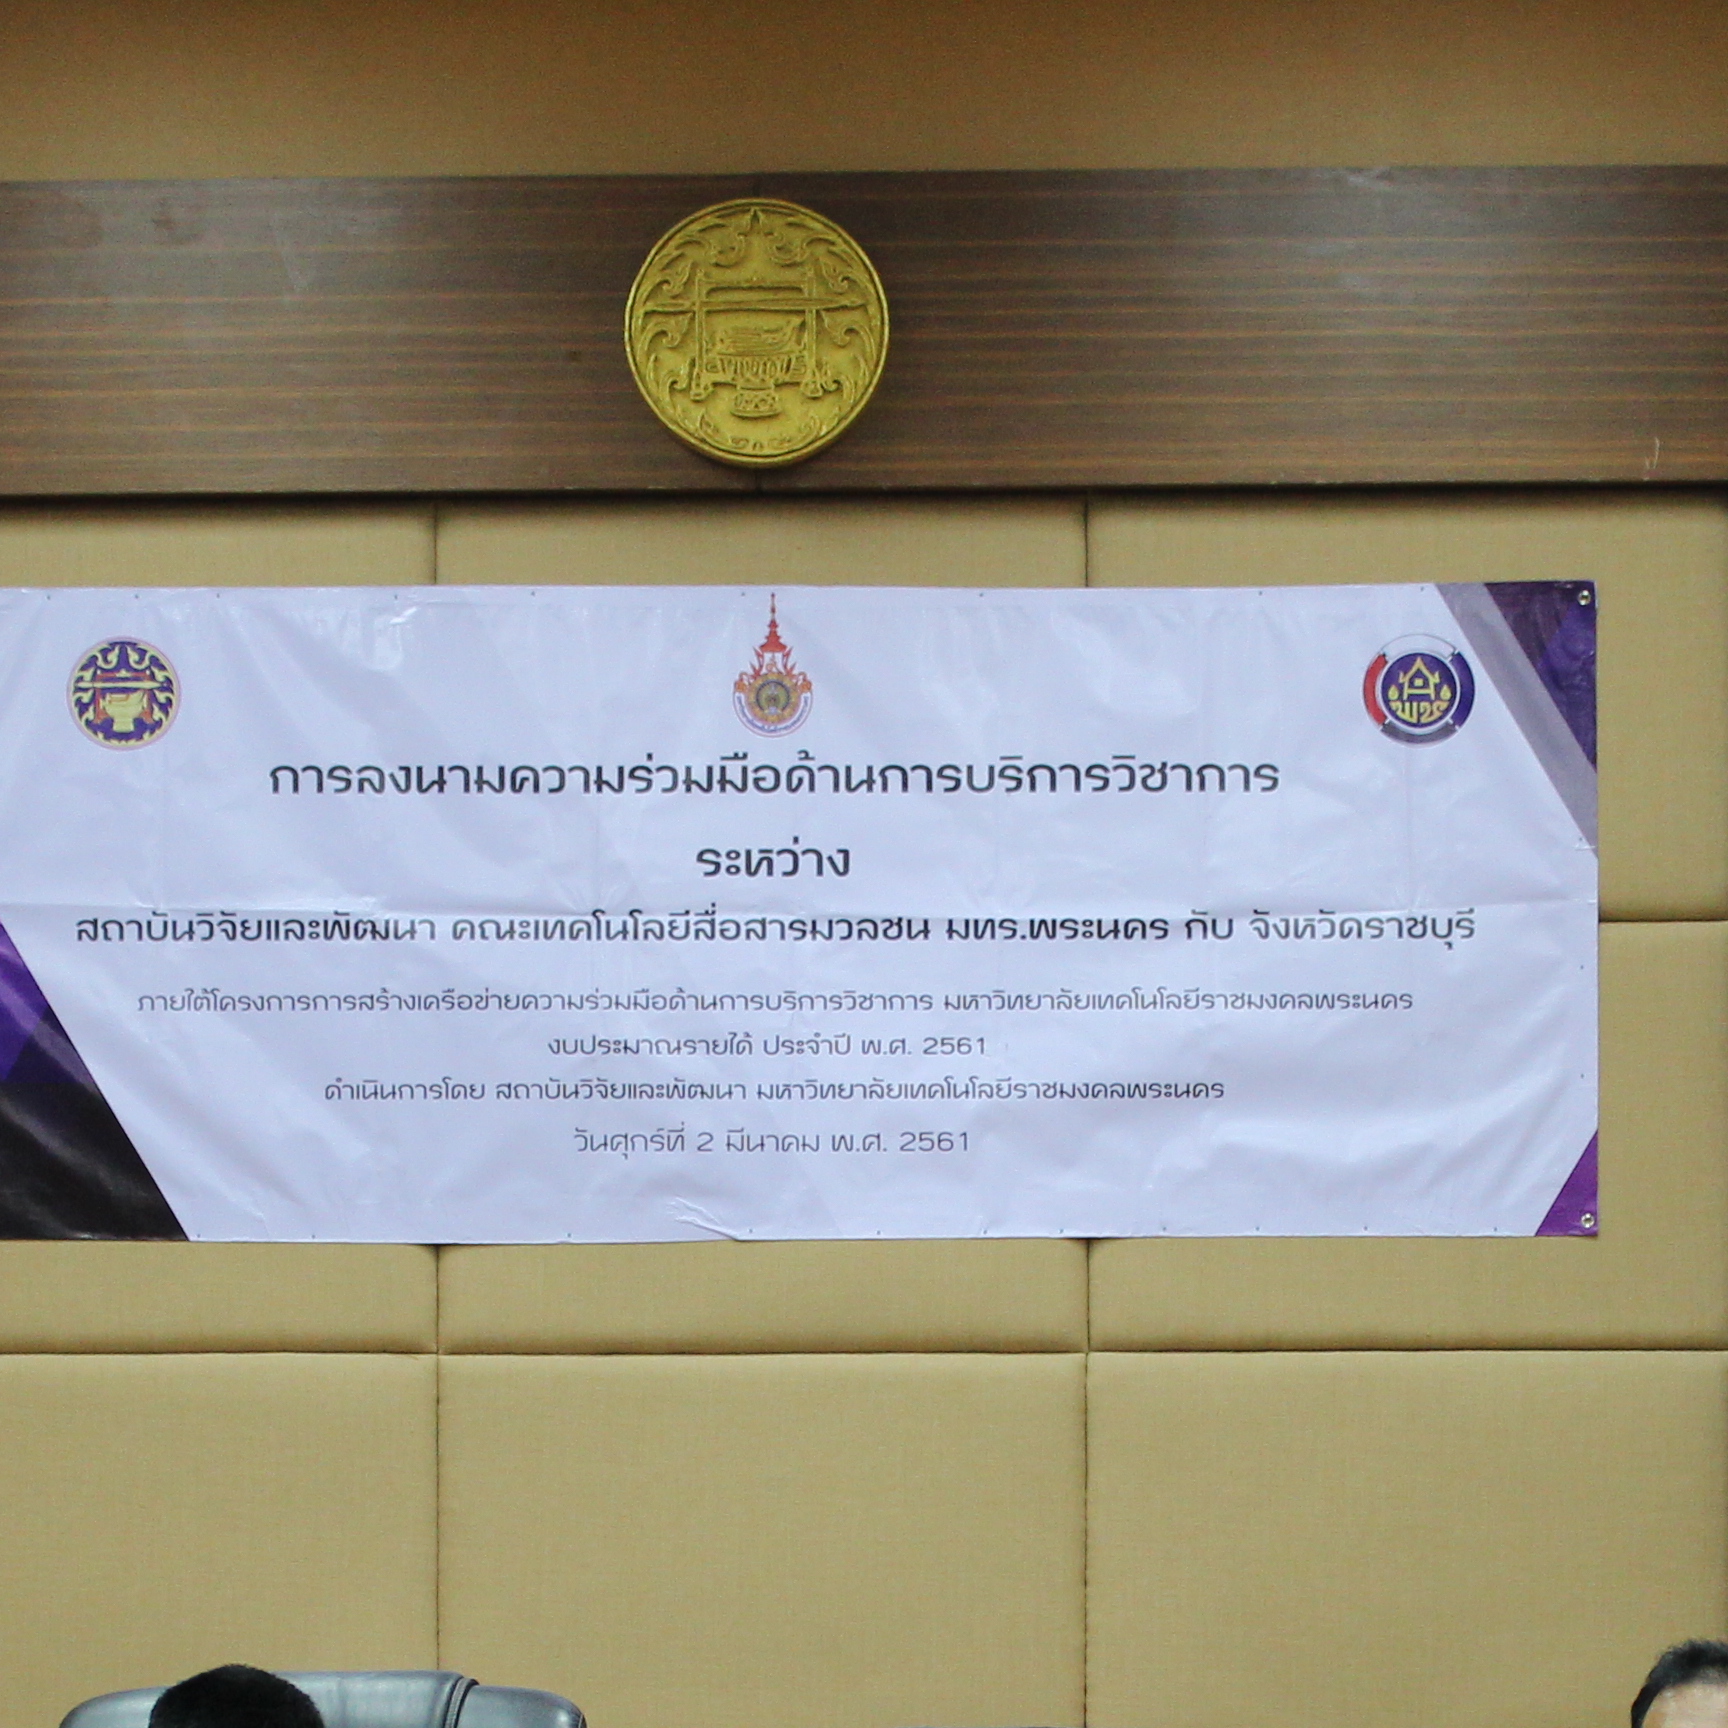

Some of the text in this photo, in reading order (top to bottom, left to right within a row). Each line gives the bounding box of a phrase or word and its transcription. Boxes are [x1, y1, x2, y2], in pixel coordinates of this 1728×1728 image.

[269, 748, 1280, 795] การลงนามความร่วมมือด้านการบริการวิชาการ
[695, 835, 851, 878] ระหว่าง
[75, 903, 1476, 950] สถาบันวิจัยและพัฒนา คณะเทคโนโลยีสื่อสารมวลชน มทร.พระนคร กับ จังหวัดราชบุรี
[137, 985, 1414, 1013] ภายใต้โครงการการสร้างเครือข่ายความร่วมมือด้านการบริการวิชาการ มหาวิทยาลัยเทคโนโลยีราชมงคลพระนคร
[547, 1030, 985, 1057] งบประมาณรายได้ ประจำปี พ.ศ. 2561
[324, 1075, 1225, 1101] ดำเนินการโดย สถาบันวิจัยและพัฒนา มหาวิทยาลัยเทคโนโลยีราชมงคลพระนคร
[573, 1123, 968, 1160] วันศุกร์ที่ 2 มีนาคม พ.ศ. 2561
